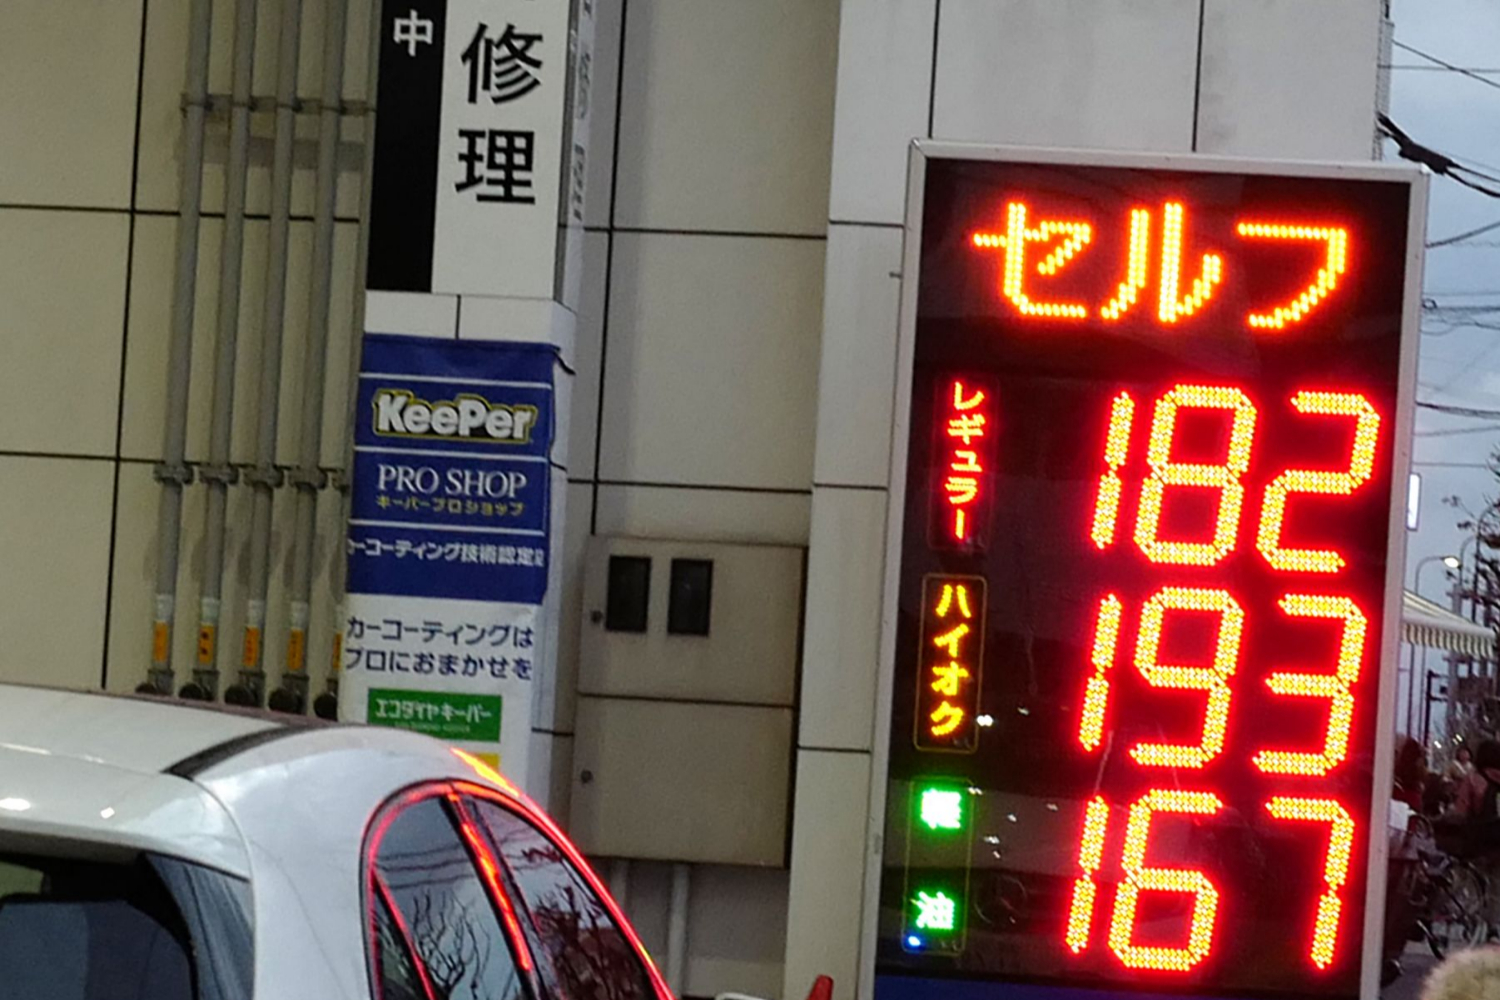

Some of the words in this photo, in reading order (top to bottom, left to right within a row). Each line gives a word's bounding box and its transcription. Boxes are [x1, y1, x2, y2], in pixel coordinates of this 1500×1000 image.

[393, 9, 434, 57] 中
[454, 22, 544, 205] 修理
[973, 201, 1348, 330] セルフ
[377, 393, 532, 440] KeePer
[377, 464, 439, 494] PRO
[444, 469, 527, 498] SHOP
[945, 381, 987, 540] レギュラー
[1090, 383, 1381, 574] 182
[345, 647, 533, 680] プロにおまかせを
[348, 616, 534, 648] カーコーティングは
[931, 584, 972, 736] ハイオク
[1079, 585, 1368, 777] 193
[1065, 787, 1355, 972] 167
